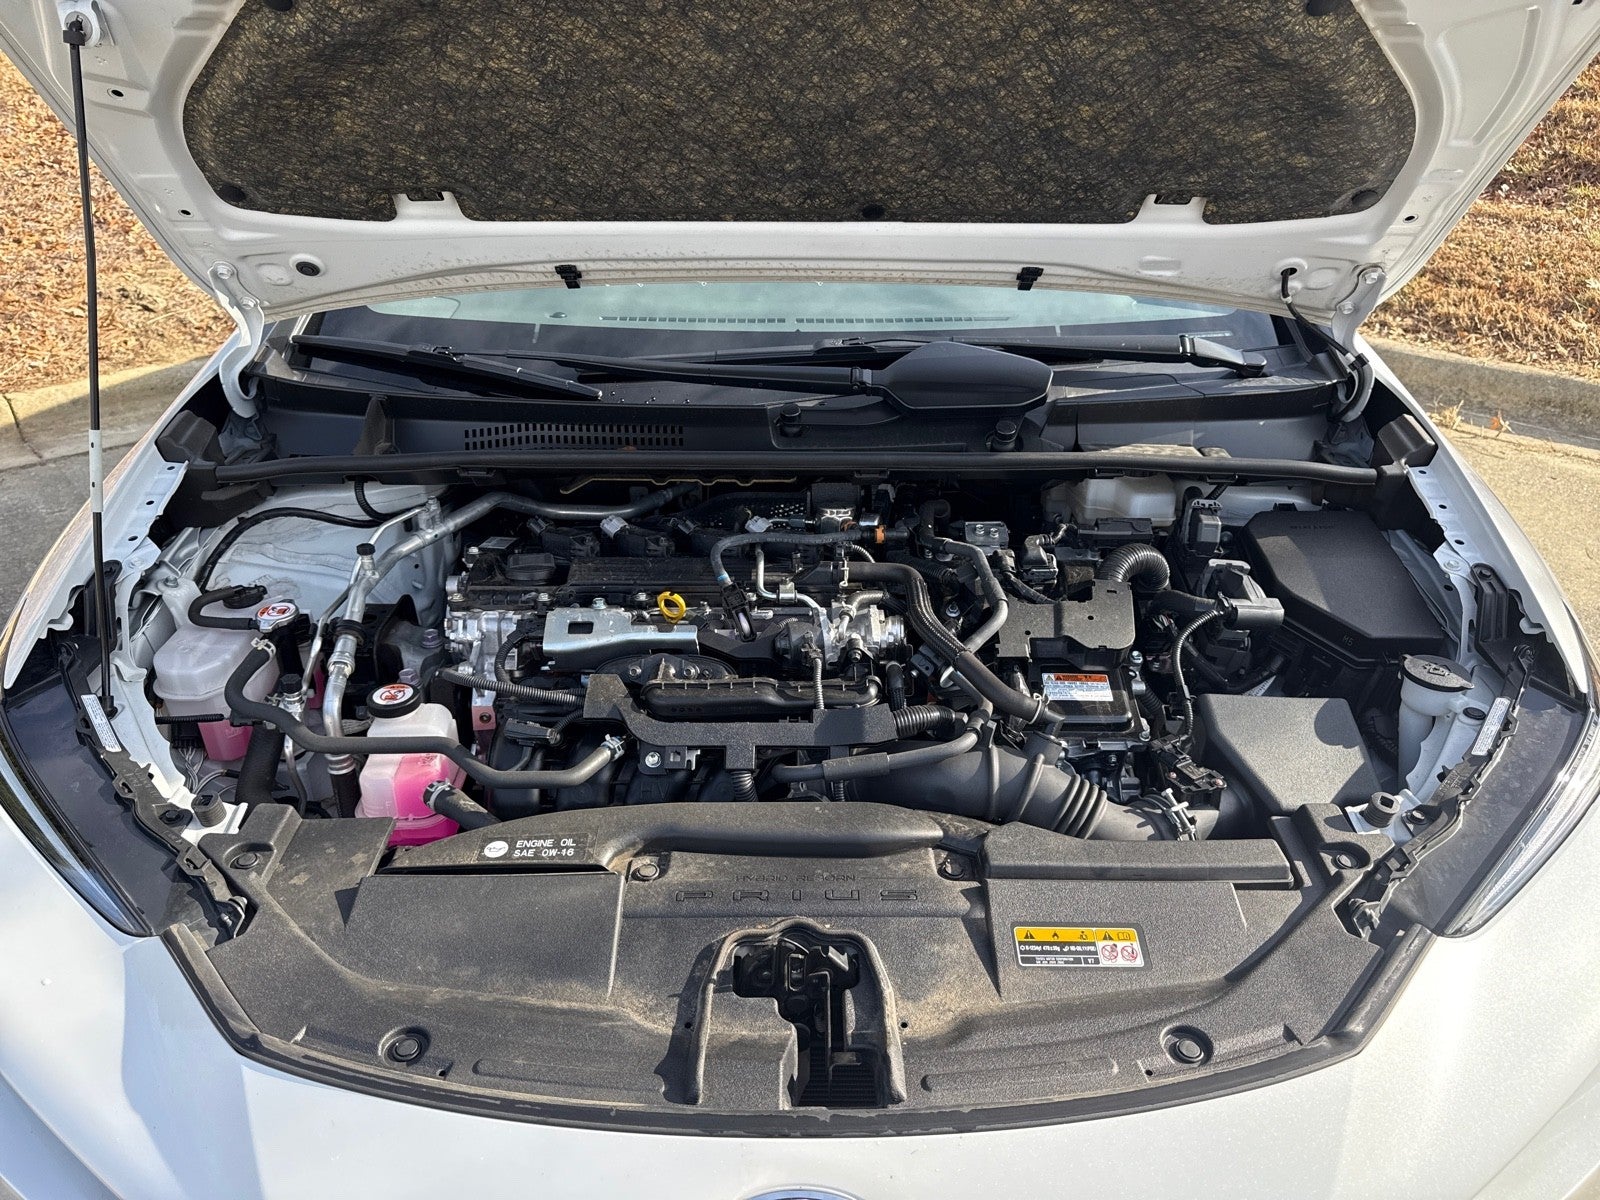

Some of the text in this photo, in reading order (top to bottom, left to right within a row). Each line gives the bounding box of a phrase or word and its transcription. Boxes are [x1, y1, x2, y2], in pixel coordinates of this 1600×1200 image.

[516, 838, 576, 847] ENGINE OIL
[675, 889, 917, 901] PRIUS
